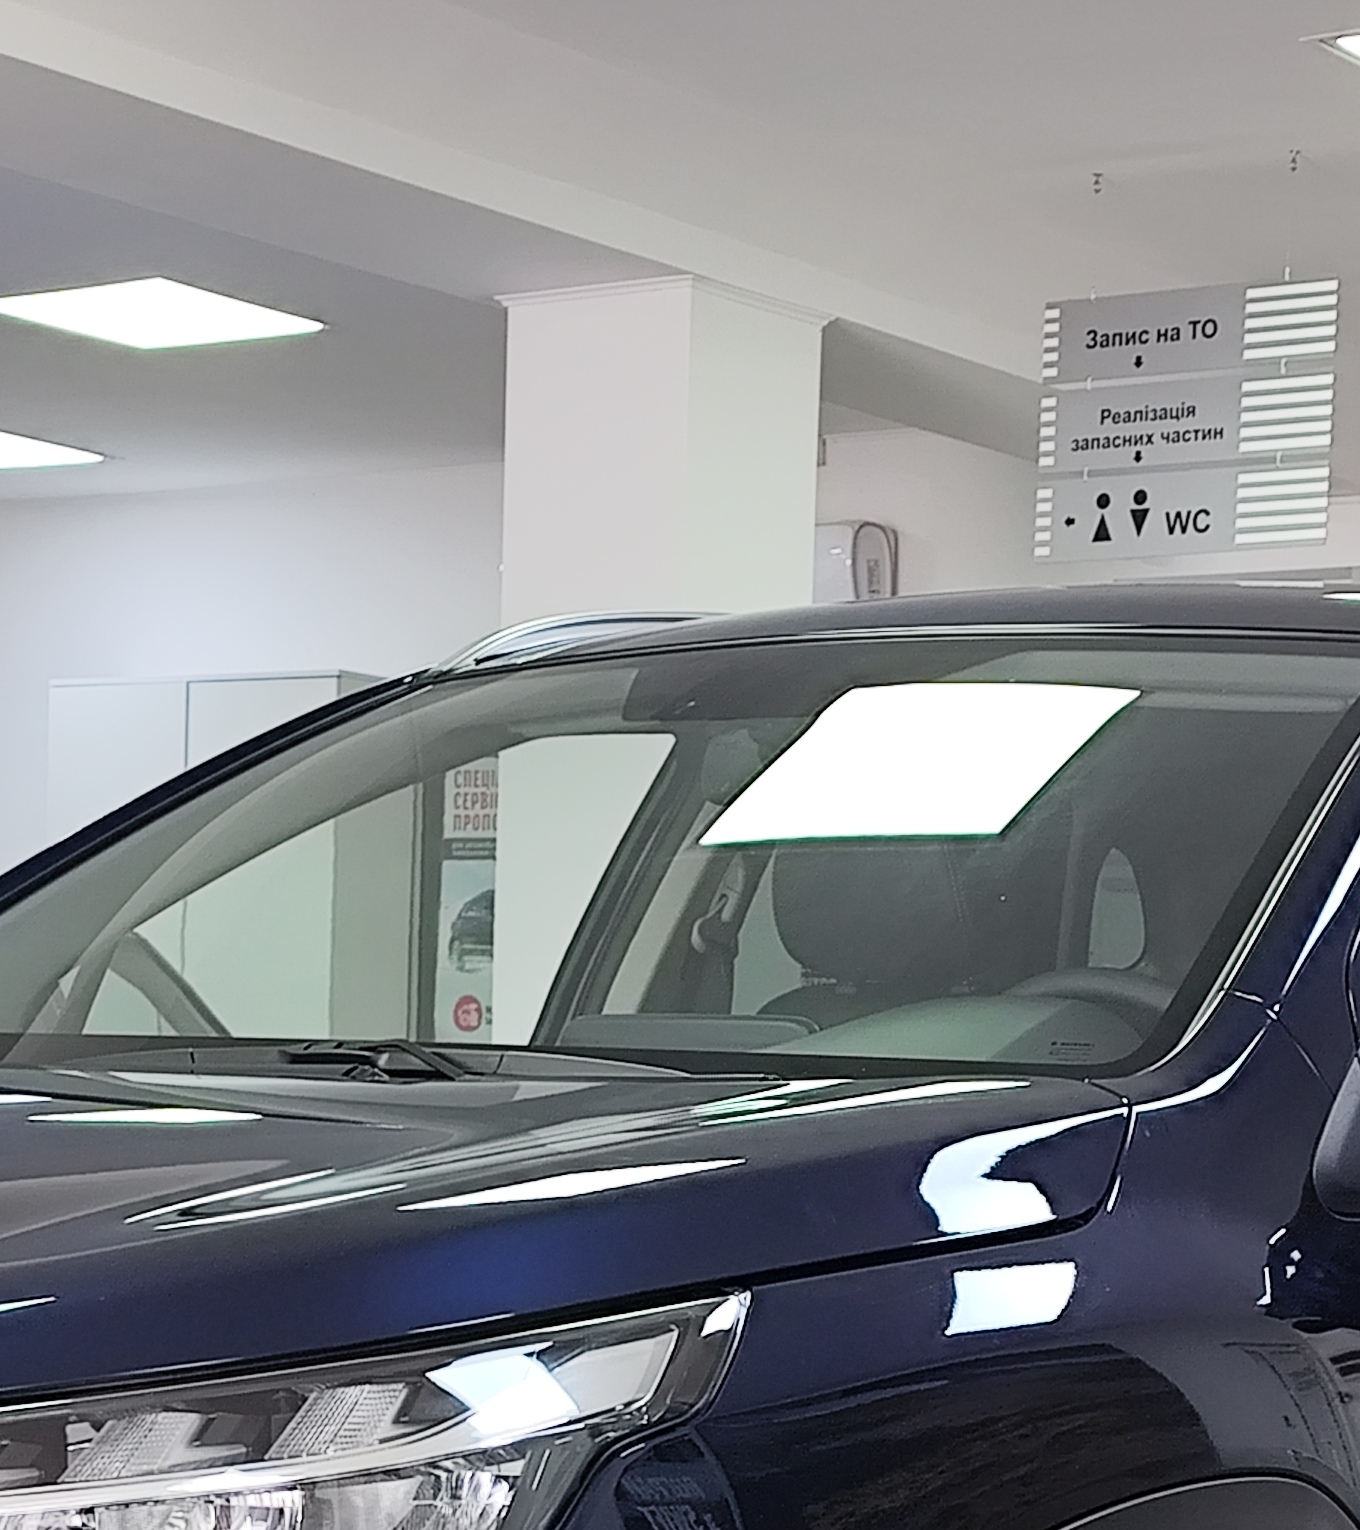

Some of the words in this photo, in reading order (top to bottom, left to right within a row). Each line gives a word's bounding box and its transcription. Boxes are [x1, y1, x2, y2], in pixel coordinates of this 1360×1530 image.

[1085, 326, 1151, 350] Запис
[1156, 325, 1181, 344] на
[1188, 319, 1218, 341] ТО
[1099, 403, 1196, 426] Реалізація
[1071, 432, 1154, 452] запасних
[1160, 426, 1224, 445] частин
[1165, 509, 1211, 536] WC
[454, 770, 498, 790] СПЕЦІ
